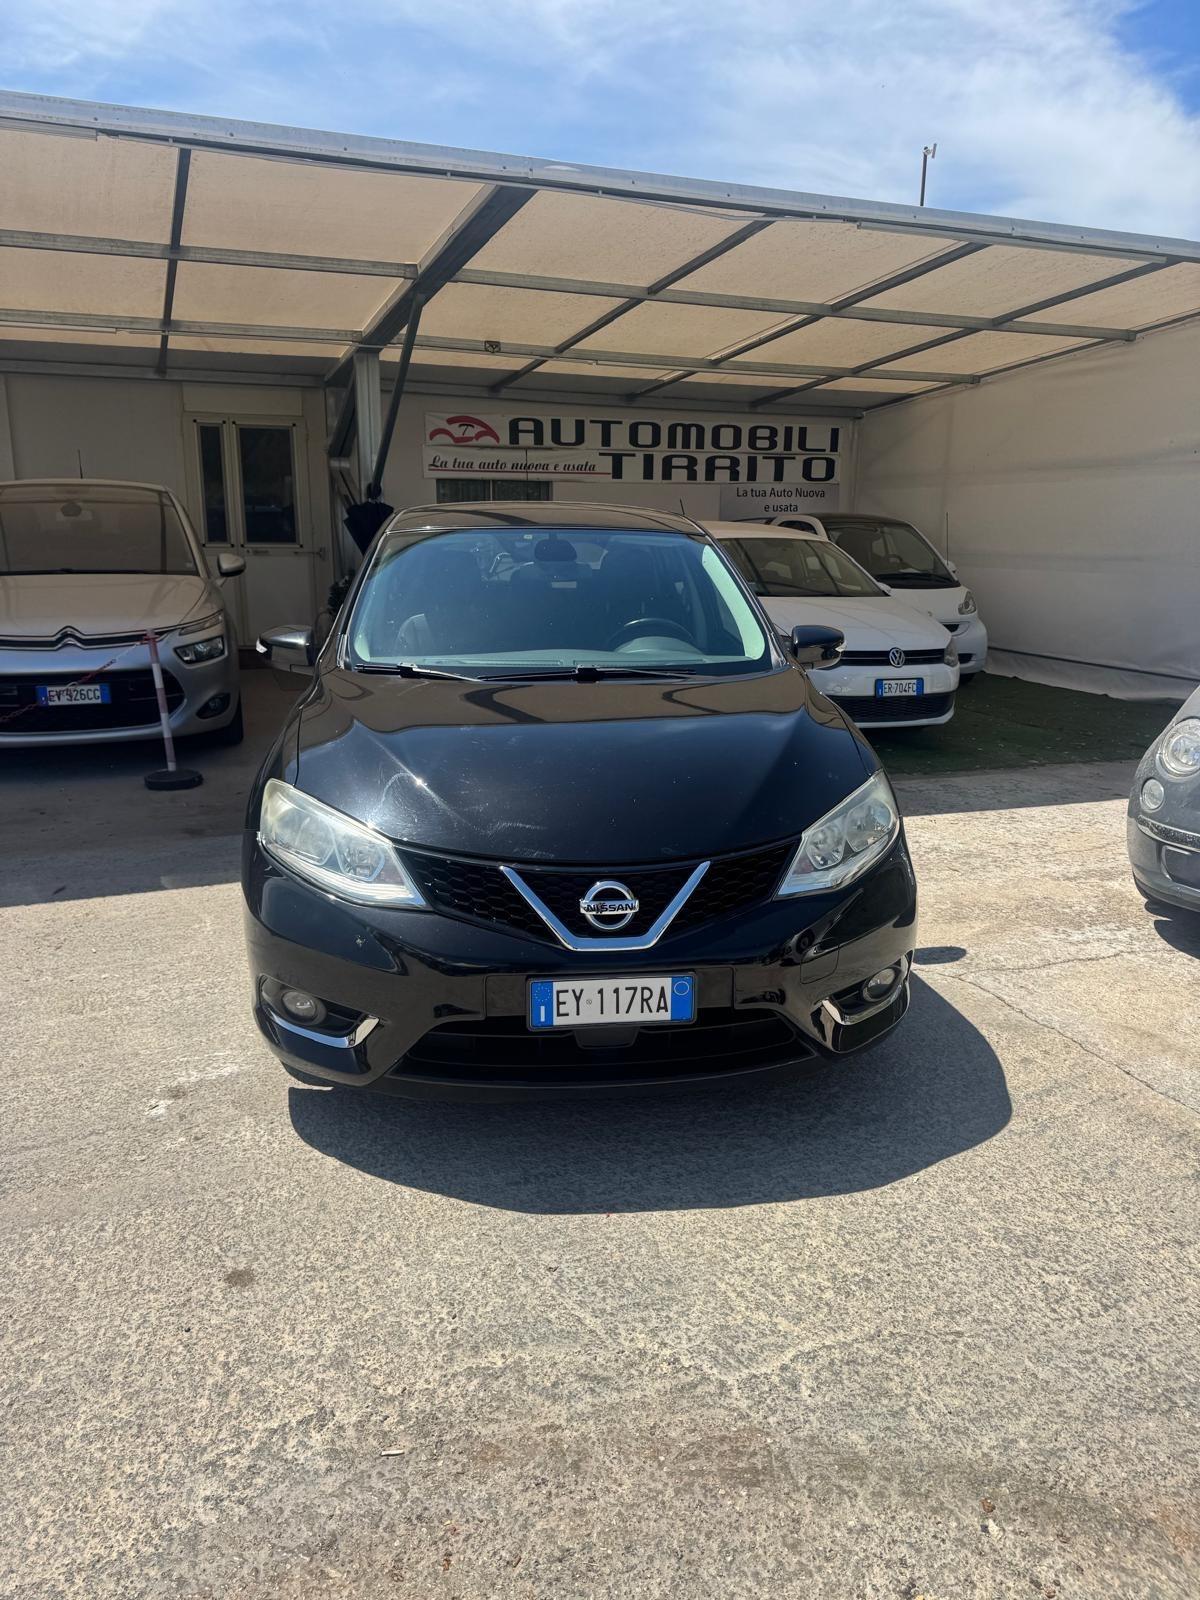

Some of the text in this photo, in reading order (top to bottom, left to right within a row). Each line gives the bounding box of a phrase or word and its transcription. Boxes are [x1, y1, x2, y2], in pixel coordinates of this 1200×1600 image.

[508, 417, 840, 453] AUTOMOBILI
[429, 455, 448, 469] La
[452, 457, 473, 469] tua
[479, 459, 507, 470] auto
[511, 461, 549, 471] nuova
[562, 461, 596, 472] usata
[599, 453, 835, 482] TIRRITO
[736, 488, 825, 498] La tua Auto Nuova
[764, 503, 798, 513] e usata
[587, 903, 633, 912] NISSAN
[556, 986, 669, 1017] EY 117RA
